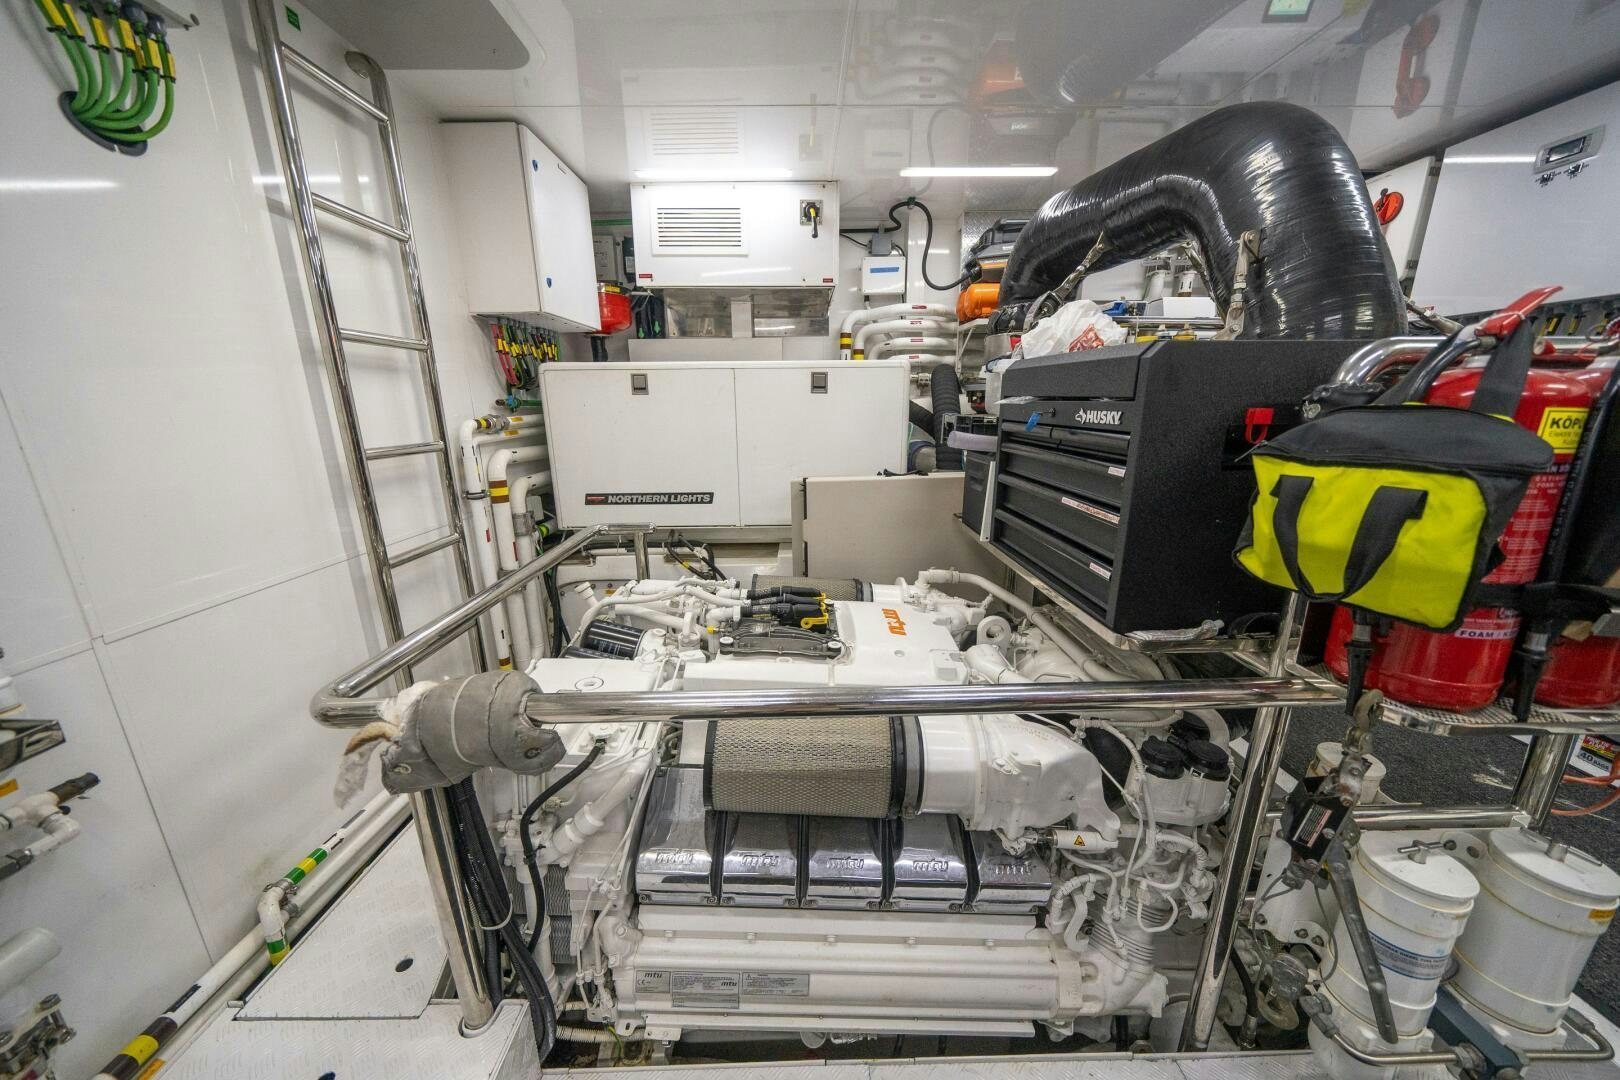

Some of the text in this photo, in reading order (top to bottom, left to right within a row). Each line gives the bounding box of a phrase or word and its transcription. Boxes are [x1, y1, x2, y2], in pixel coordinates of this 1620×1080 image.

[1085, 410, 1122, 425] HUSKY
[607, 494, 711, 504] NORTHERN LIGHTS
[881, 607, 907, 636] mtu
[1459, 629, 1495, 638] FOAM
[912, 858, 949, 873] mtu
